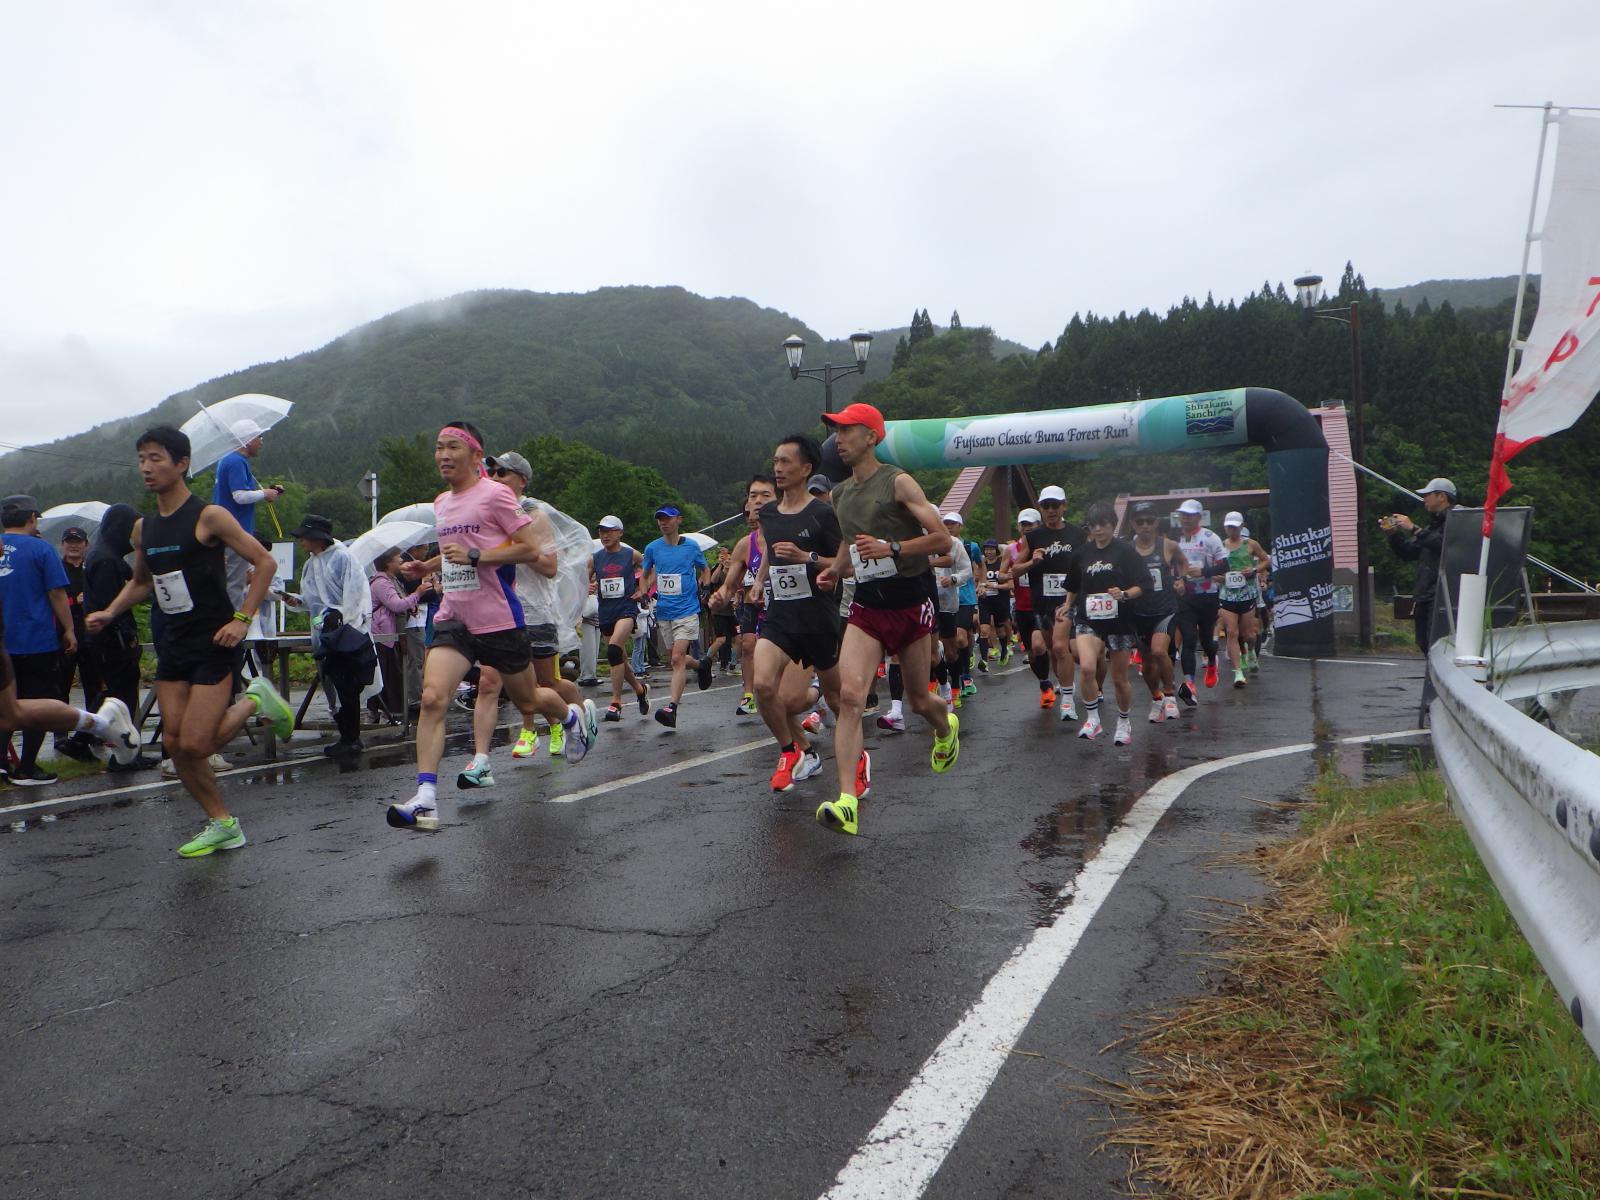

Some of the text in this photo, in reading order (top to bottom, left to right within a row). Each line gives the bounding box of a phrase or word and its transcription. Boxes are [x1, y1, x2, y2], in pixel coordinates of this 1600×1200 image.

[1186, 400, 1232, 410] Shirakami
[1186, 409, 1216, 419] Sanchi
[954, 425, 1128, 455] Fujisato Classic Buna Forest Run
[1277, 541, 1322, 562] Sanchi
[604, 583, 620, 592] 187
[663, 580, 675, 588] 70
[779, 575, 797, 589] 63
[160, 586, 171, 602] 3
[1091, 600, 1112, 611] 218
